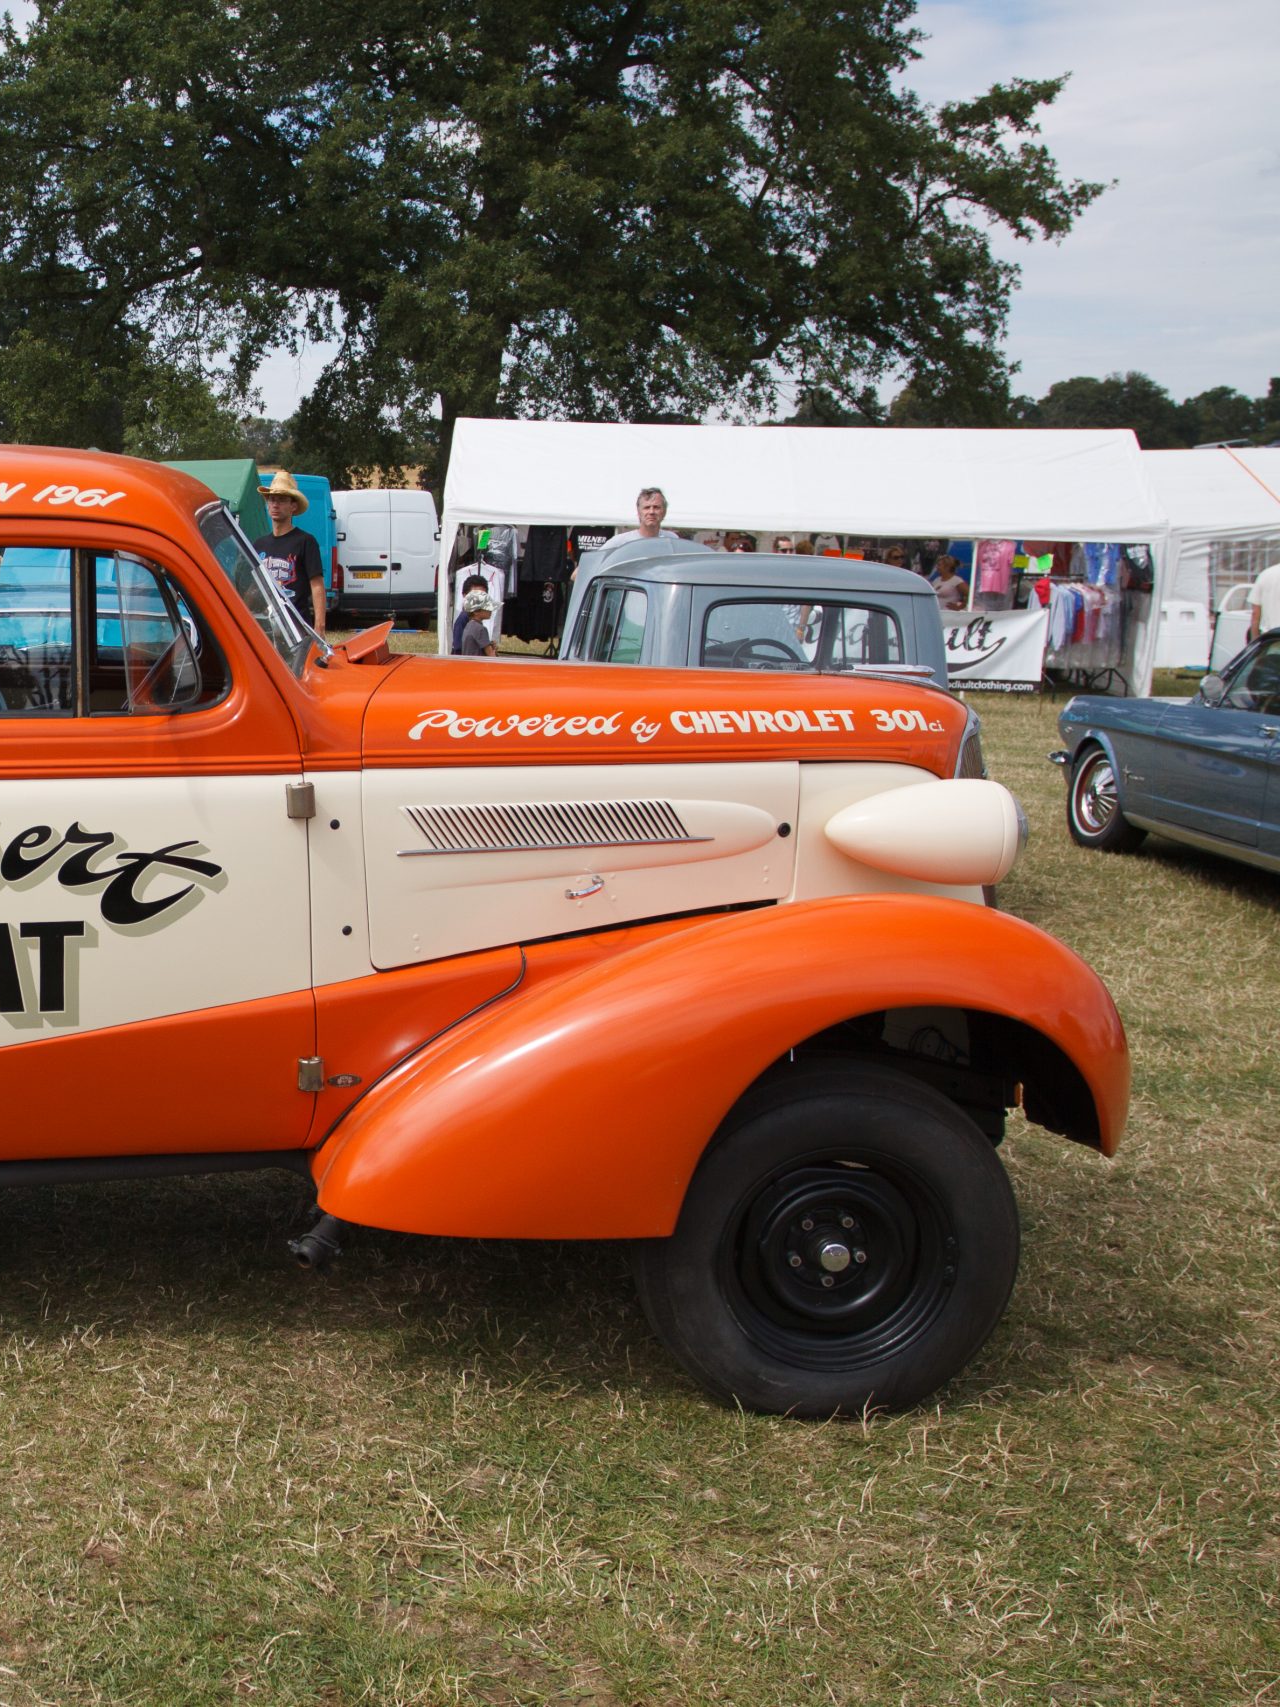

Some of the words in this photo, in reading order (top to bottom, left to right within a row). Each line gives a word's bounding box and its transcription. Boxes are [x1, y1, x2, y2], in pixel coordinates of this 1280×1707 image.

[32, 484, 126, 508] 1961
[408, 709, 623, 740] Powered
[630, 717, 661, 743] by
[670, 710, 855, 734] CHEVROLET
[875, 709, 927, 732] 301
